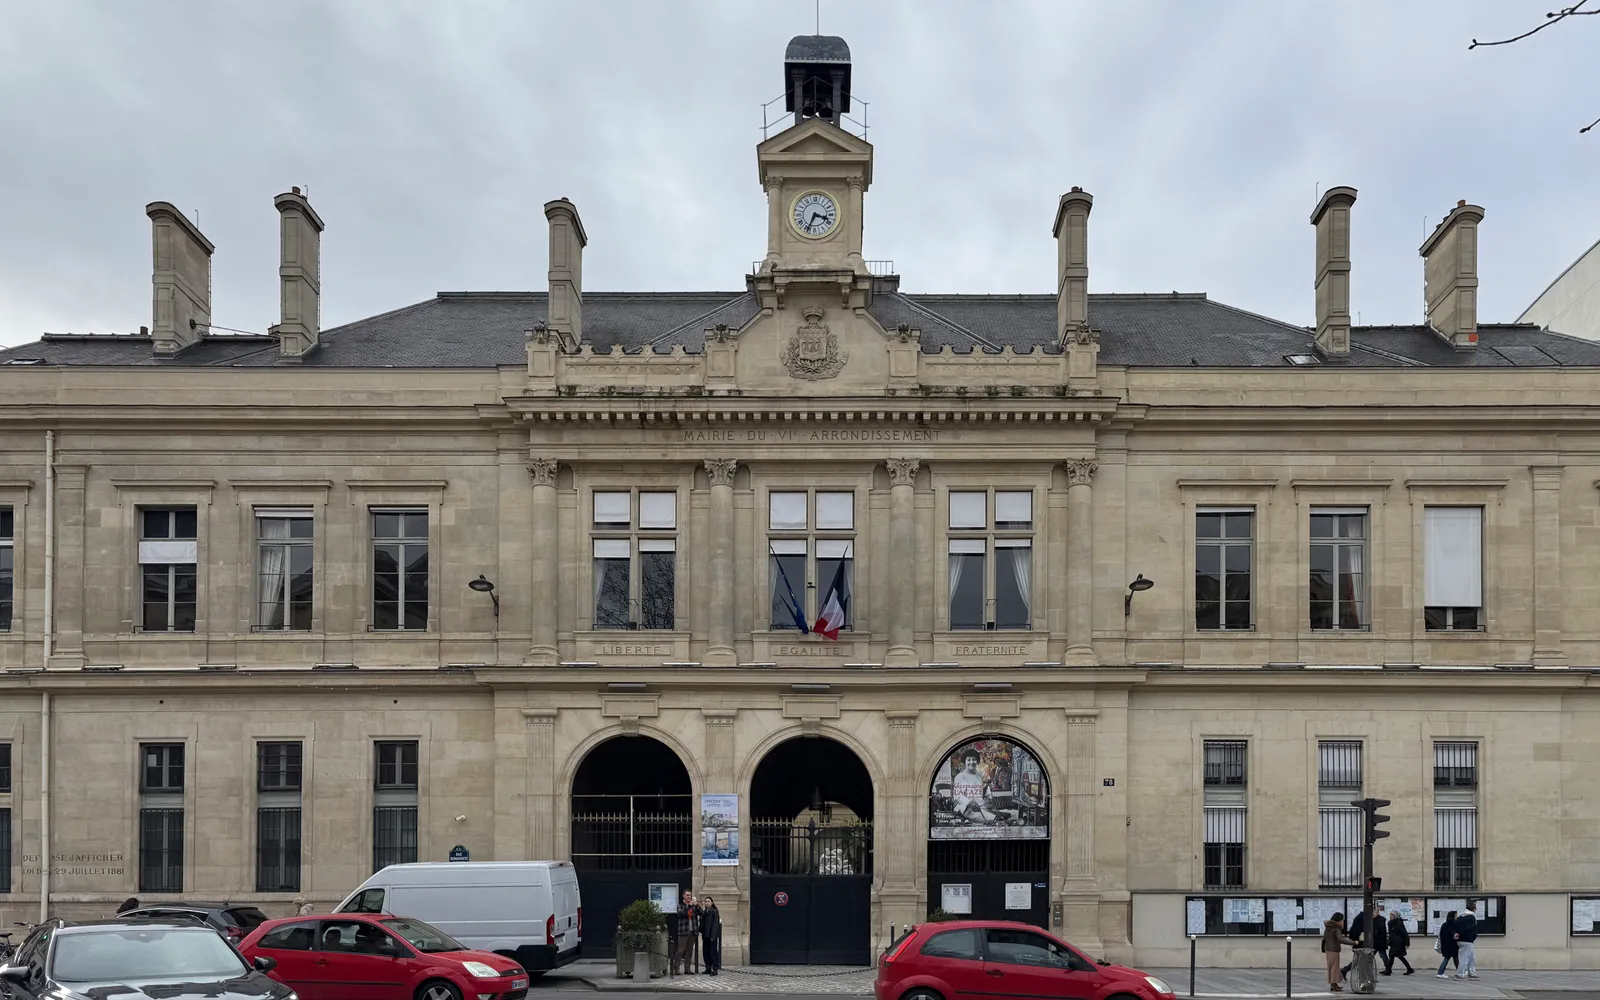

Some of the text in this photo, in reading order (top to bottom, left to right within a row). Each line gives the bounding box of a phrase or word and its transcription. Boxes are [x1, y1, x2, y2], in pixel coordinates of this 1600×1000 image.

[683, 430, 735, 441] MAIRIE
[747, 430, 766, 441] DU
[810, 430, 941, 441] ARRONDISSEMENT
[602, 646, 661, 654] LIBERTE
[781, 646, 840, 655] EGALITE
[956, 646, 1026, 655] FRATERNITE
[23, 853, 68, 862] DEFNSE
[55, 867, 67, 875] 29
[69, 867, 105, 875] JUILLET
[108, 867, 124, 875] 1881
